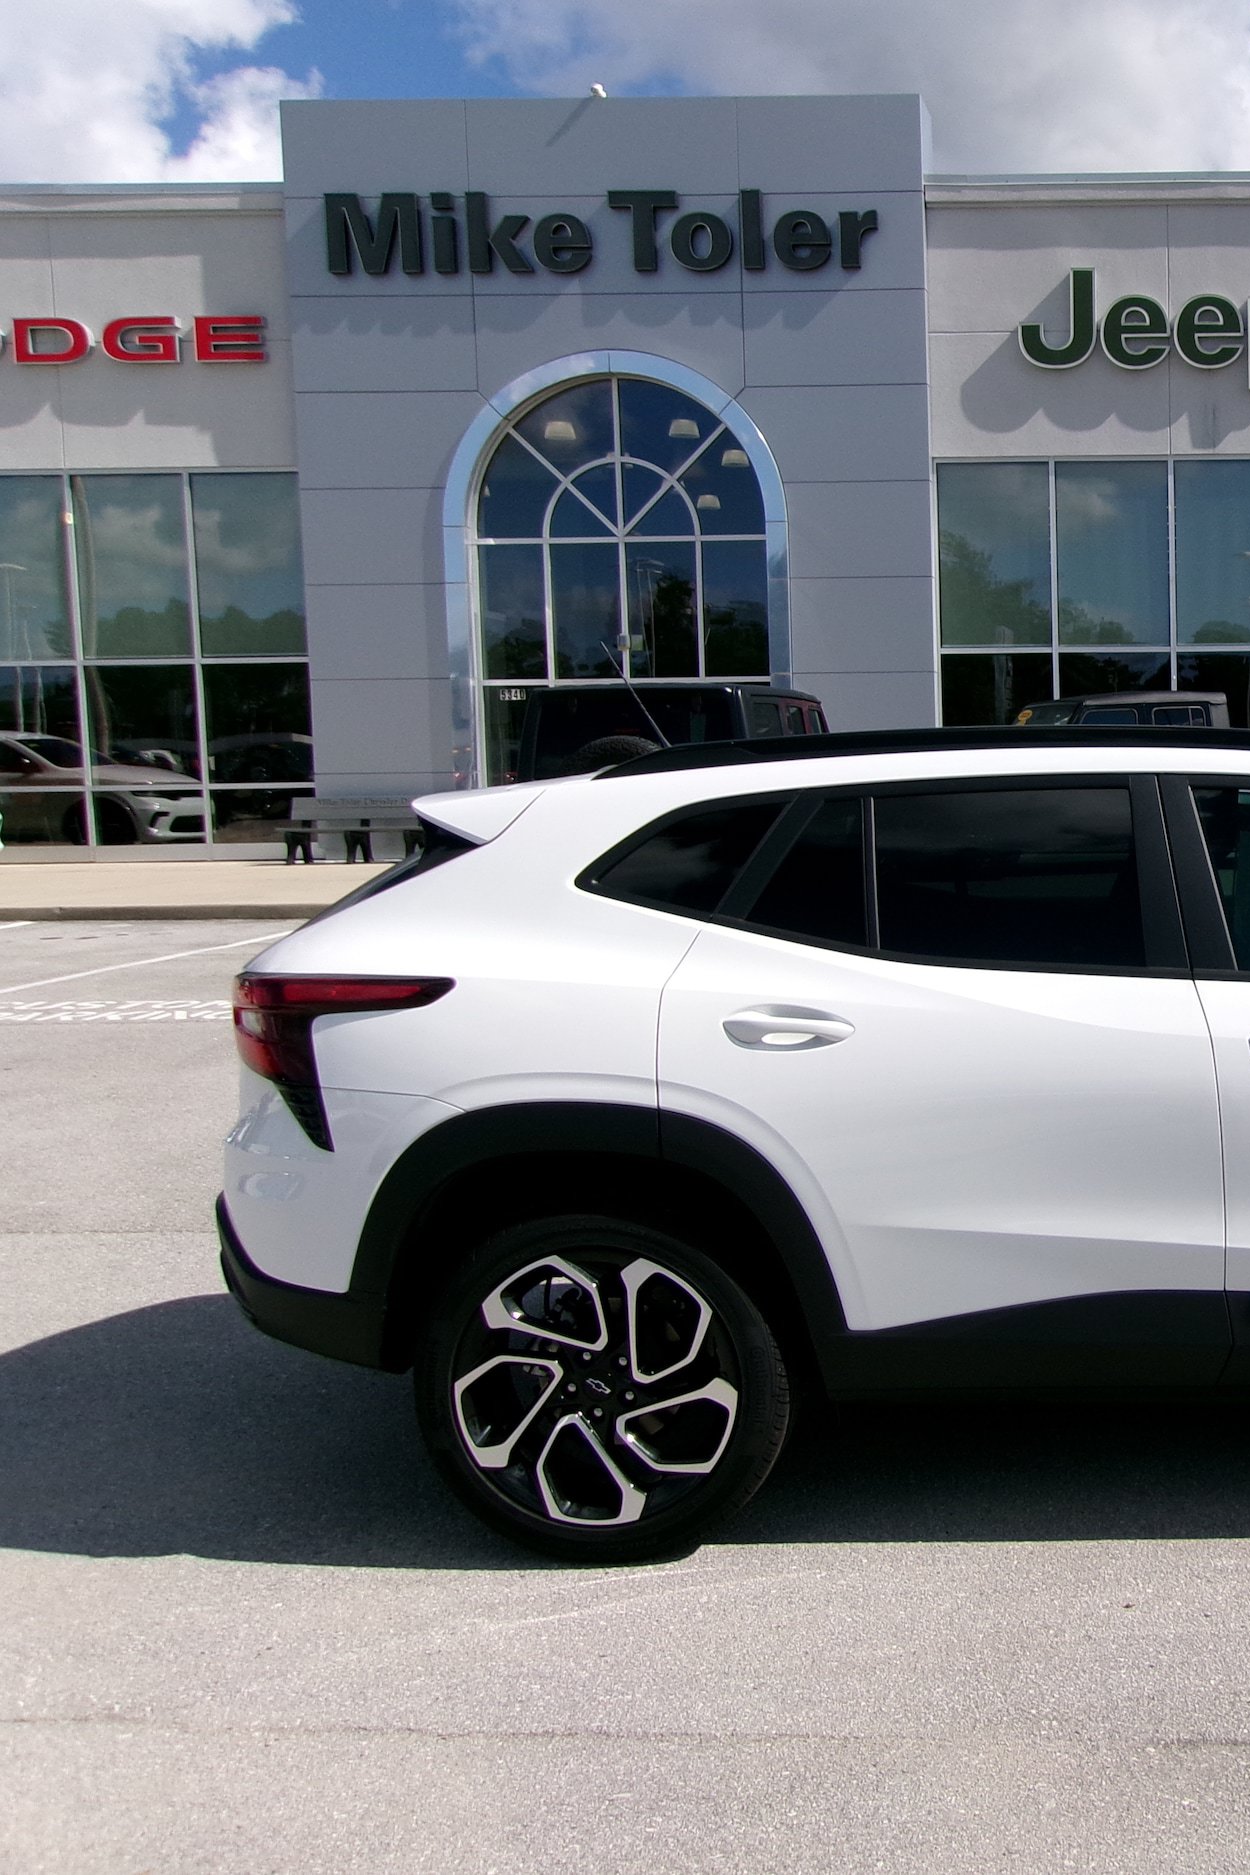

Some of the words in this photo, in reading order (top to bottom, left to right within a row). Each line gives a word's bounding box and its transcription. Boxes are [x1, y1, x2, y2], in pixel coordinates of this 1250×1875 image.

[324, 192, 593, 275] Mike
[607, 188, 879, 272] Toler
[0, 316, 266, 364] DGE
[501, 689, 525, 700] 5340
